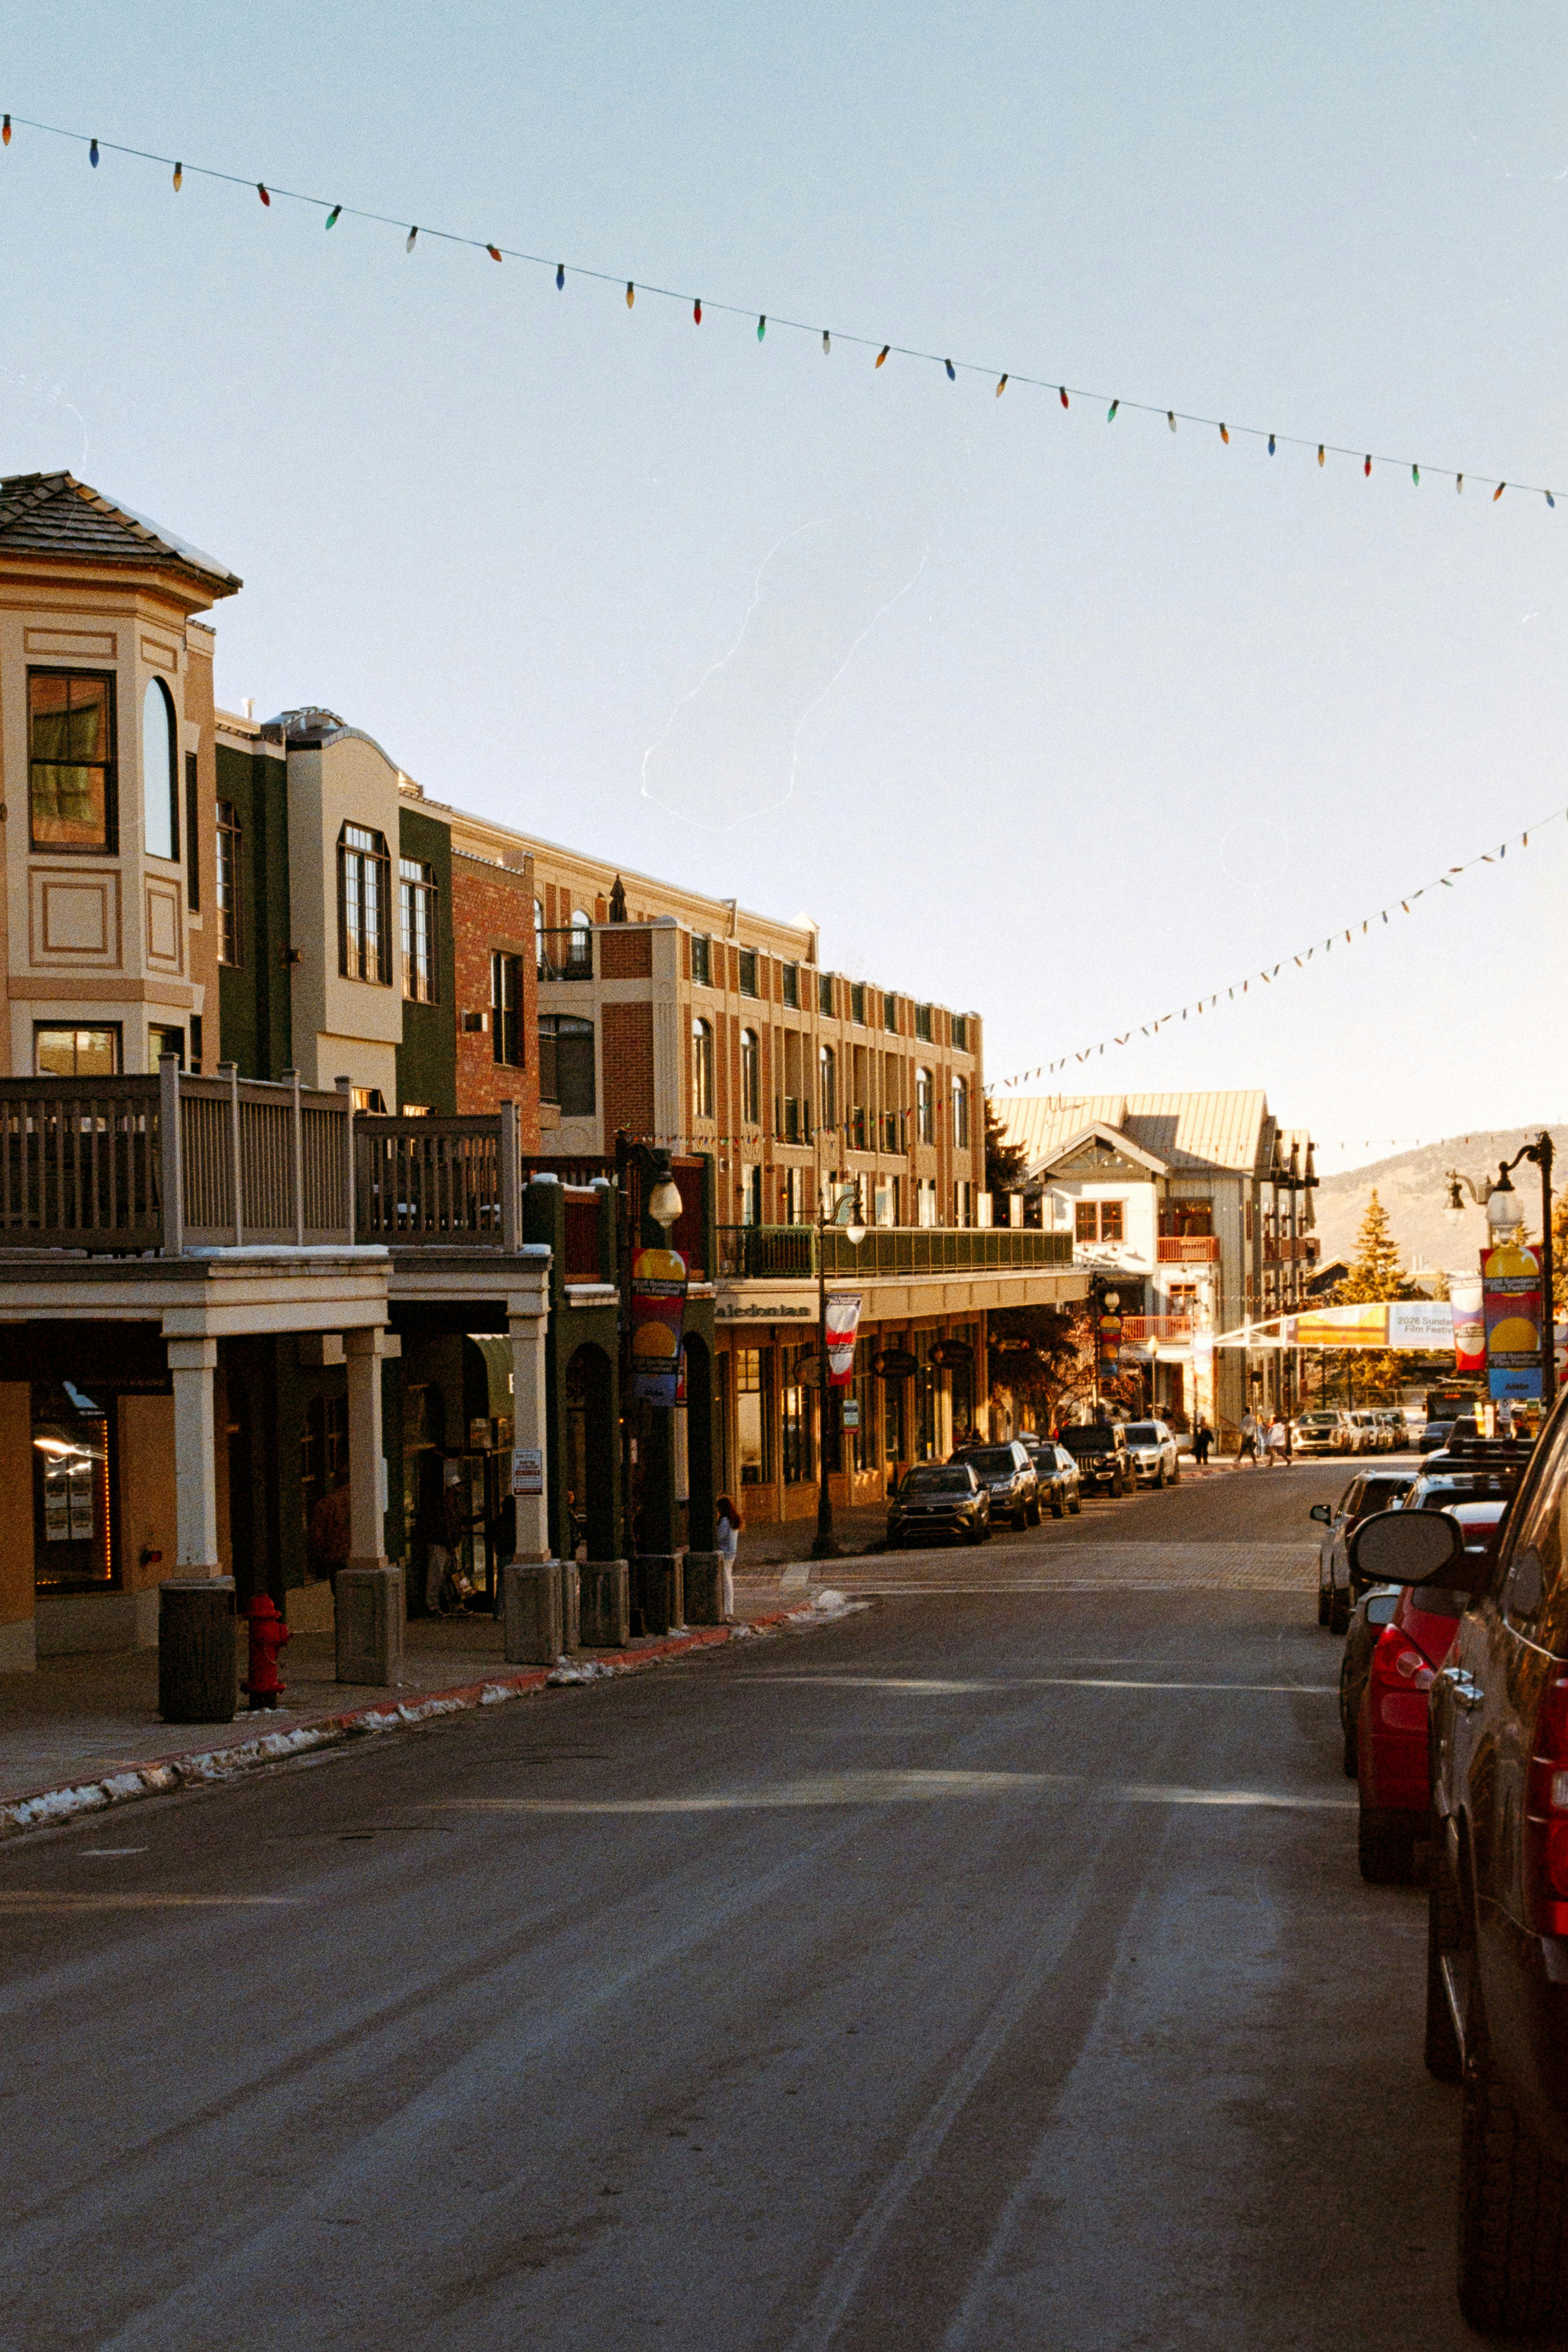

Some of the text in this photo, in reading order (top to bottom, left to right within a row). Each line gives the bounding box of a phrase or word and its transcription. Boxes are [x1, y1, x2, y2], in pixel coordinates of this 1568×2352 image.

[652, 1287, 680, 1295] Festival
[716, 1304, 811, 1317] aledonian
[1422, 1317, 1453, 1325] Sunda
[1404, 1325, 1423, 1333] Film
[1425, 1325, 1453, 1334] Festiv
